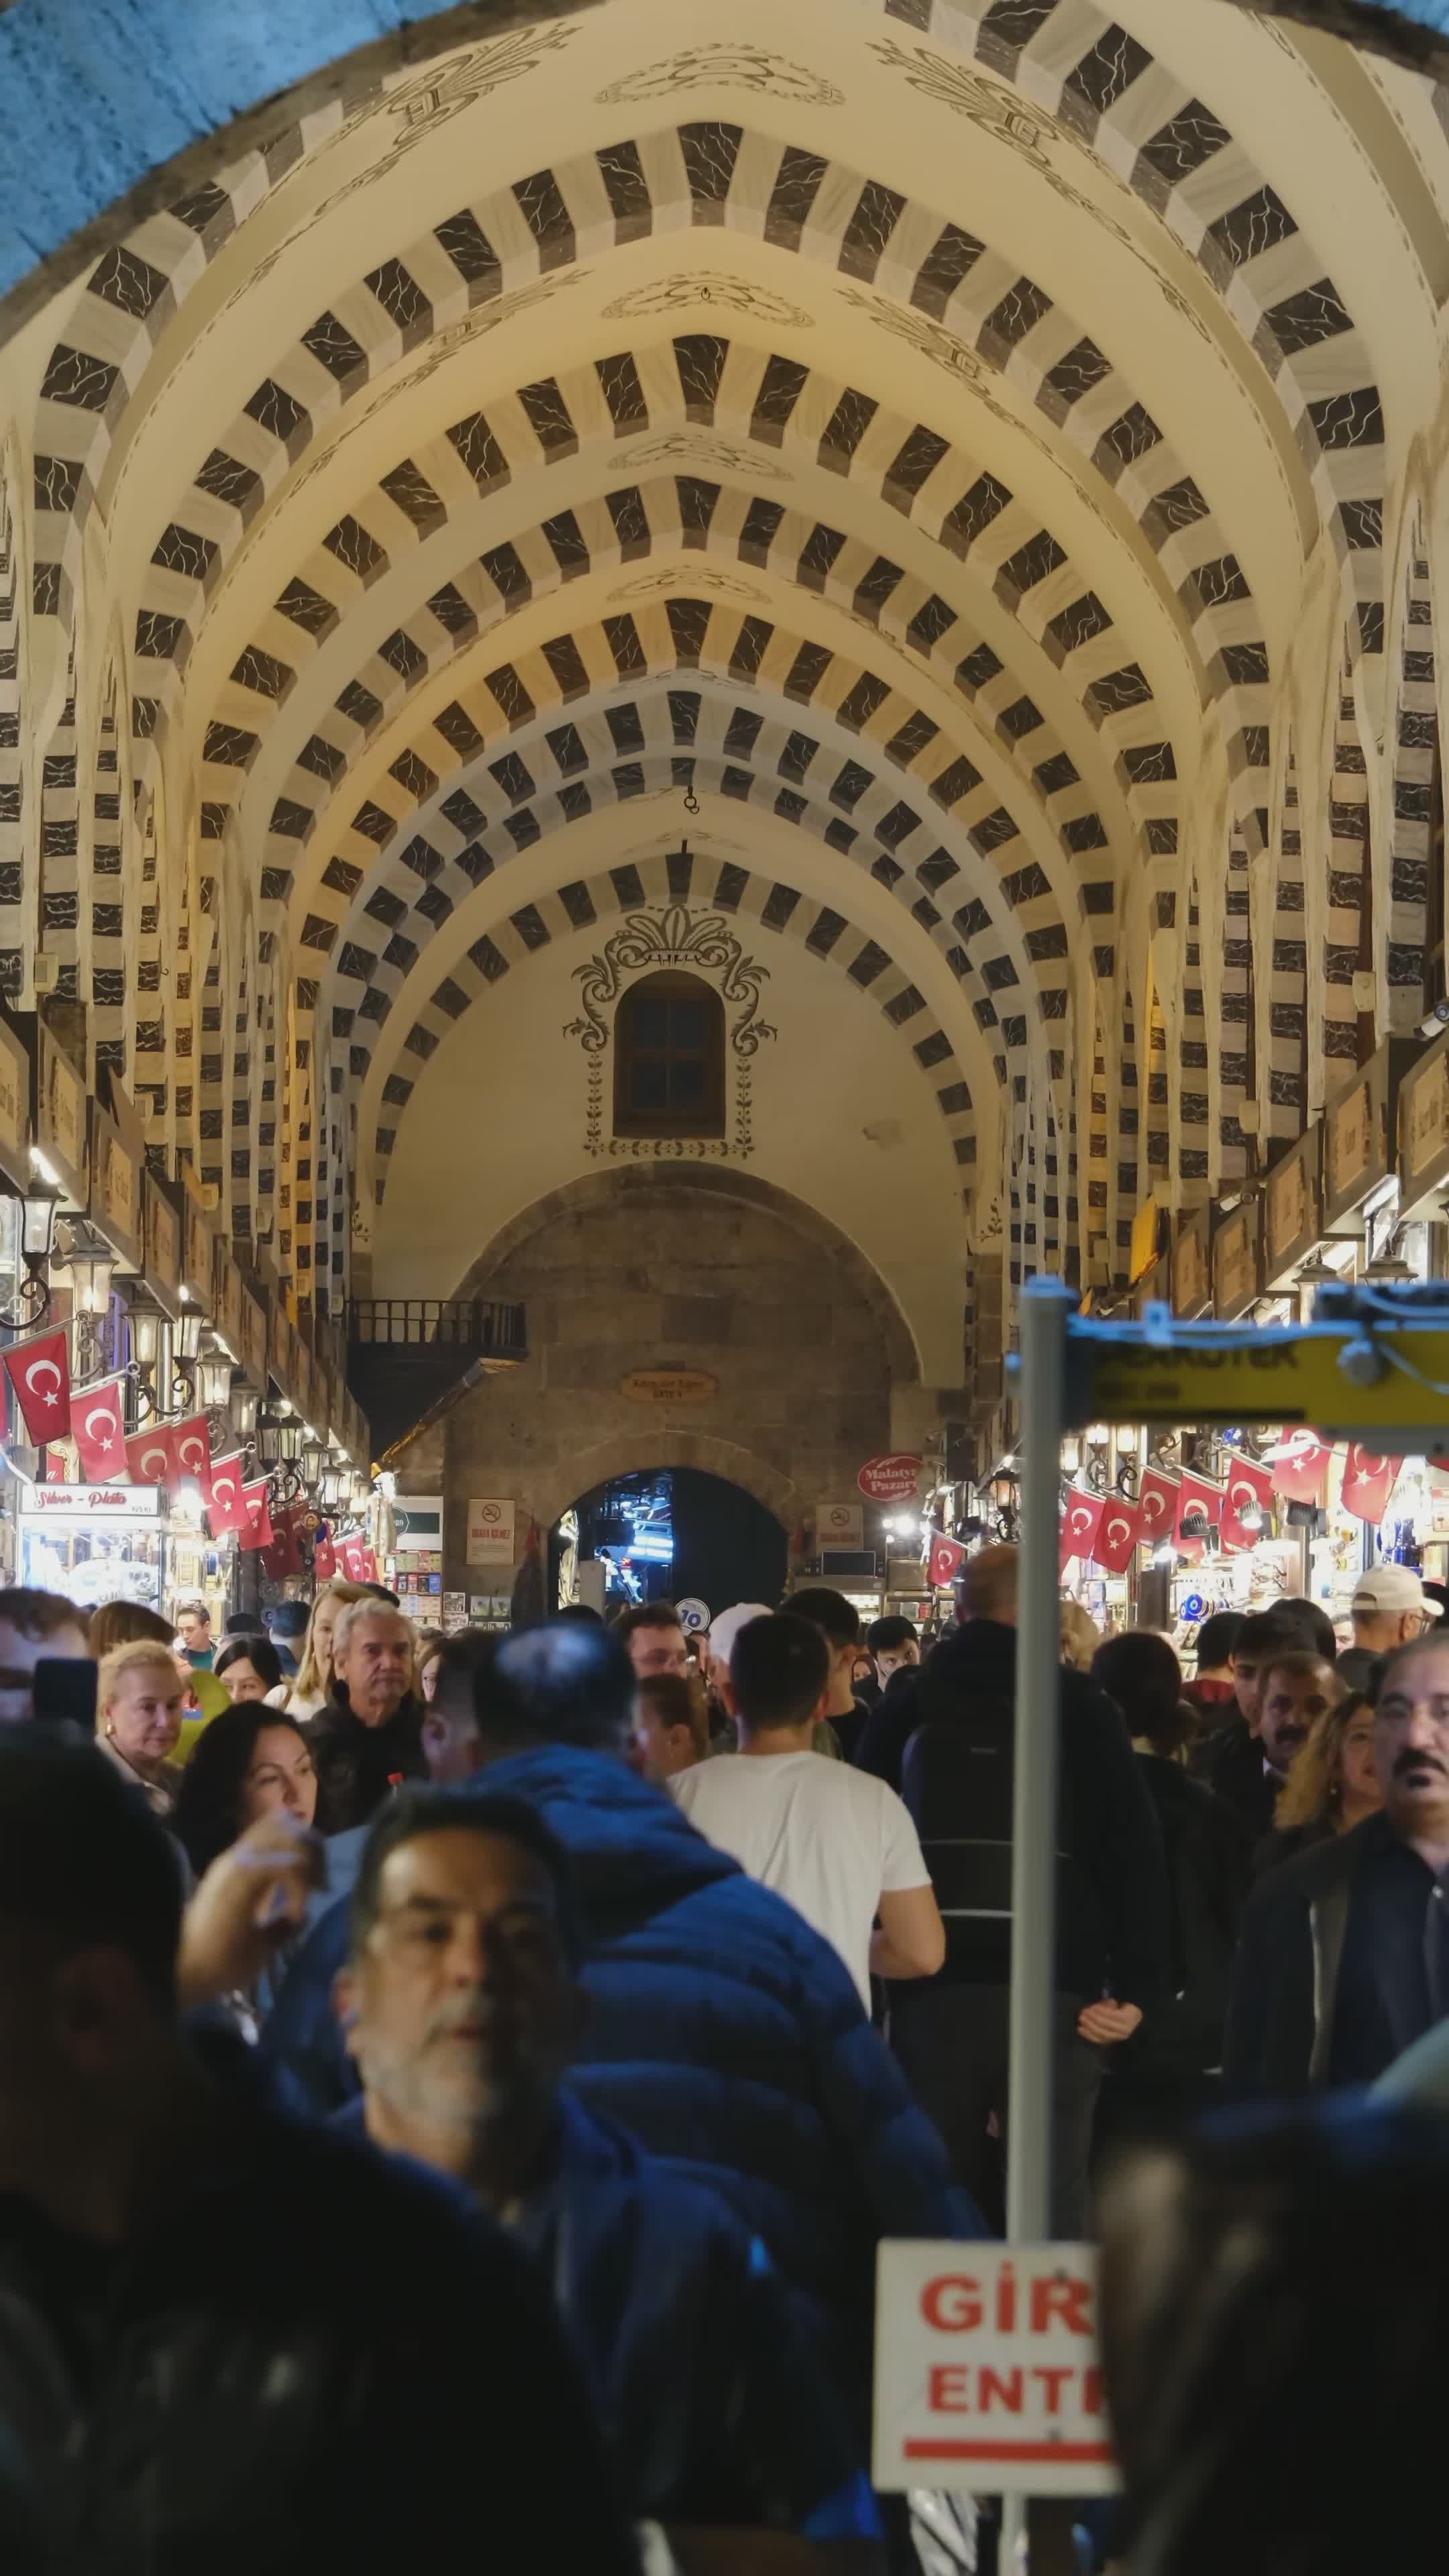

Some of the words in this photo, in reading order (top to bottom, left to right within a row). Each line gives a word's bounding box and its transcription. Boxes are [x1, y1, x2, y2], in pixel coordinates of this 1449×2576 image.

[37, 1491, 72, 1508] Silver
[682, 1609, 702, 1627] 10
[919, 2259, 1095, 2335] GİR
